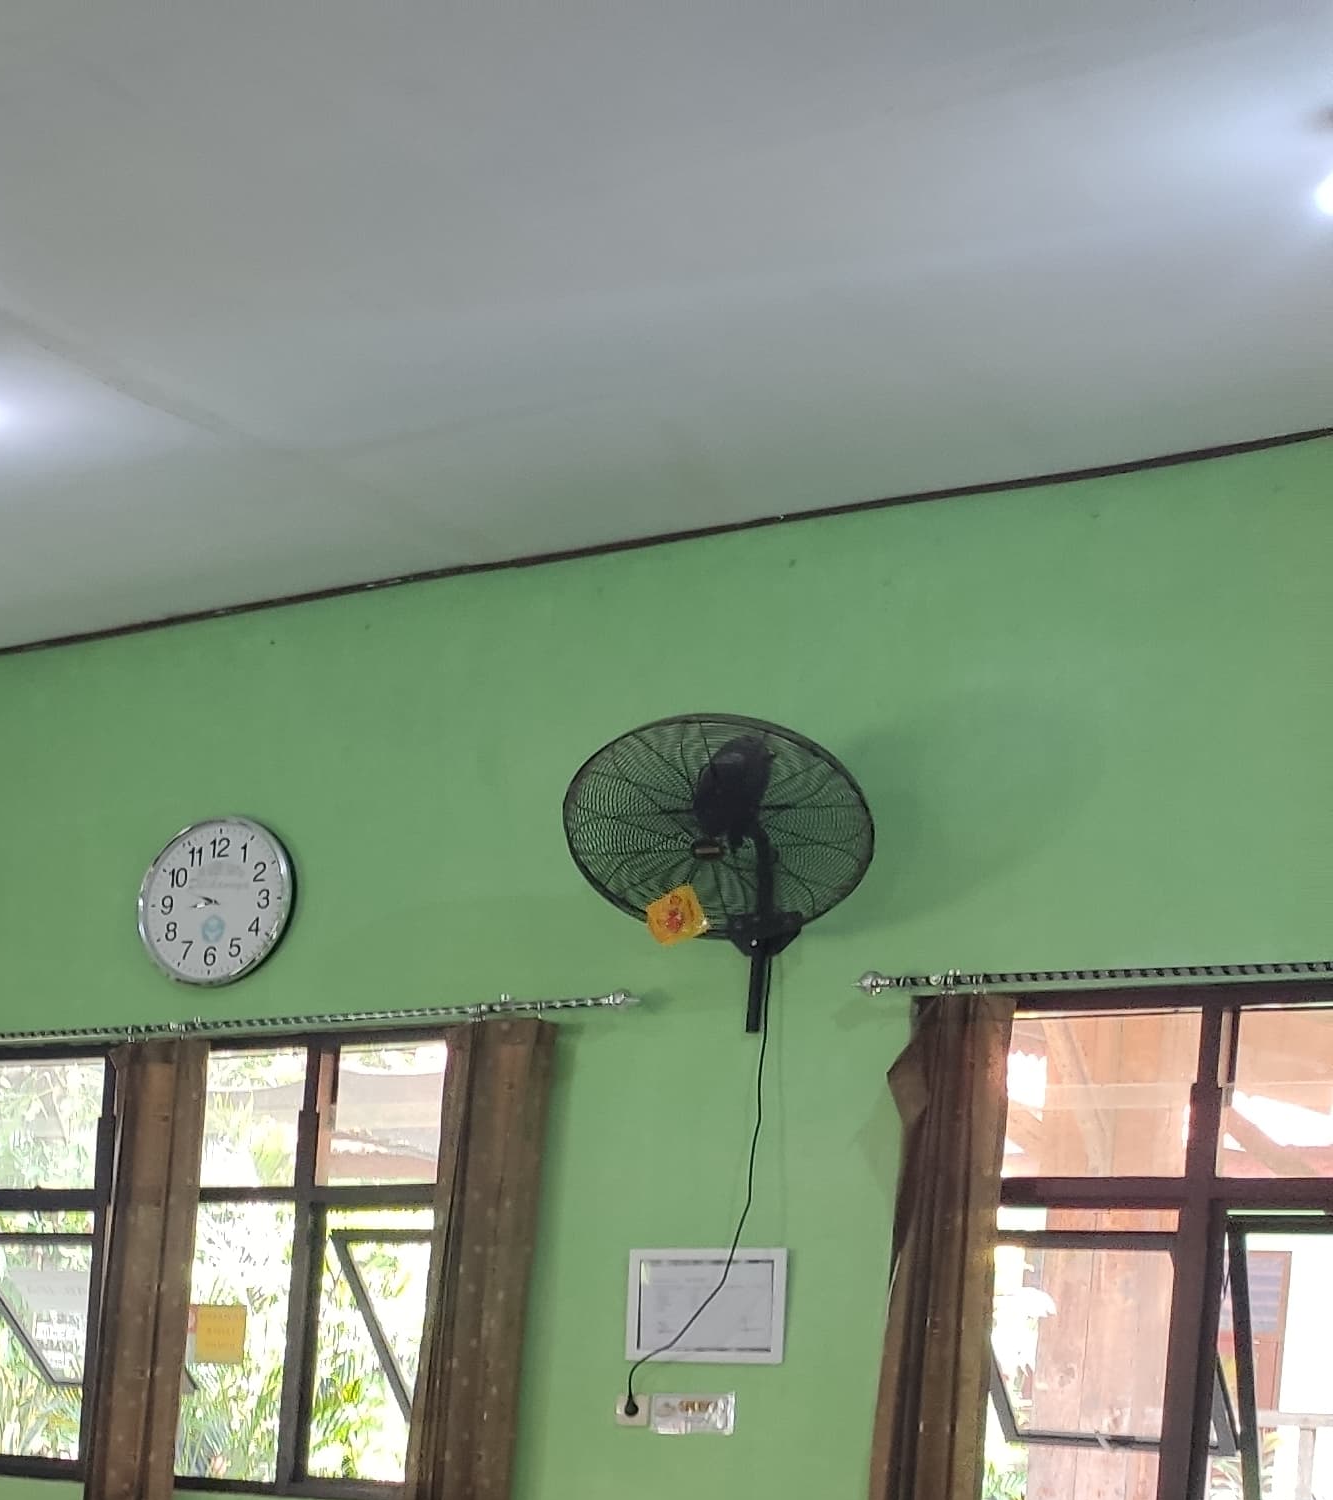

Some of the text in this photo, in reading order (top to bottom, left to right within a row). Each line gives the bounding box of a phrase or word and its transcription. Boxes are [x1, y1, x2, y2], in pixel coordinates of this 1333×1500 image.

[189, 847, 203, 867] 11
[210, 837, 230, 858] 12
[241, 843, 247, 863] 1
[170, 868, 188, 888] 10
[253, 862, 266, 882] 2
[161, 895, 174, 915] 9
[257, 889, 270, 909] 3
[165, 922, 177, 942] 8
[248, 917, 260, 936] 4
[181, 941, 193, 960] 7
[203, 946, 217, 966] 6
[228, 938, 241, 957] 5
